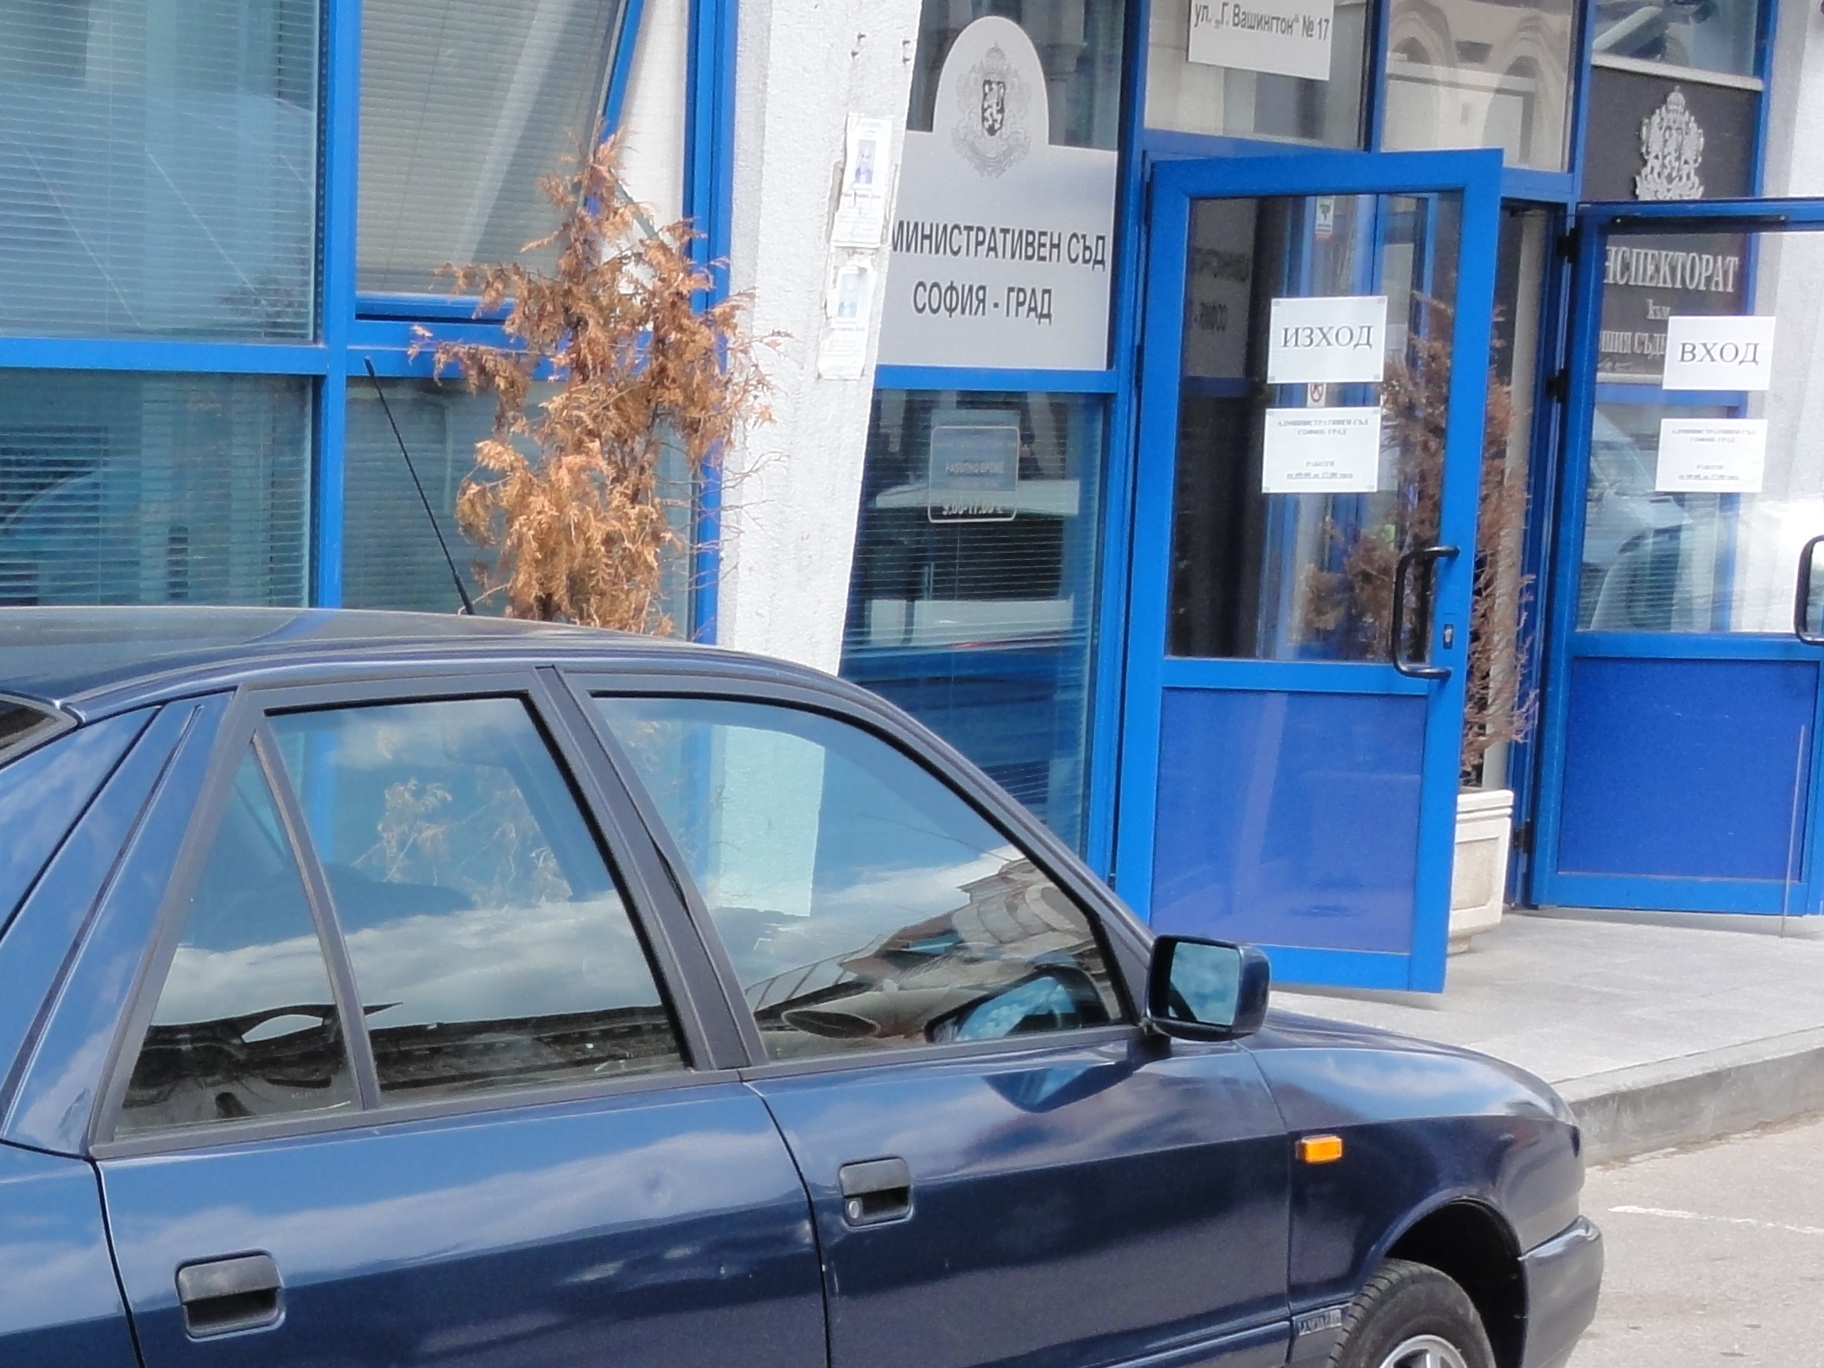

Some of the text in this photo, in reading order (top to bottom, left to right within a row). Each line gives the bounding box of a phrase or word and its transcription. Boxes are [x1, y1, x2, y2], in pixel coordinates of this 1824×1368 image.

[1194, 4, 1212, 28] ул.
[1302, 16, 1314, 38] №
[1317, 18, 1330, 41] 17
[1067, 232, 1106, 272] СЪД
[1604, 246, 1738, 292] НСПЕКТОРАТ
[913, 281, 987, 318] СОФИЯ
[1005, 286, 1053, 325] ГРАД
[1282, 325, 1374, 350] ИЗХОД
[1600, 331, 1632, 354] ШИЯ
[1679, 342, 1760, 367] ВХОД
